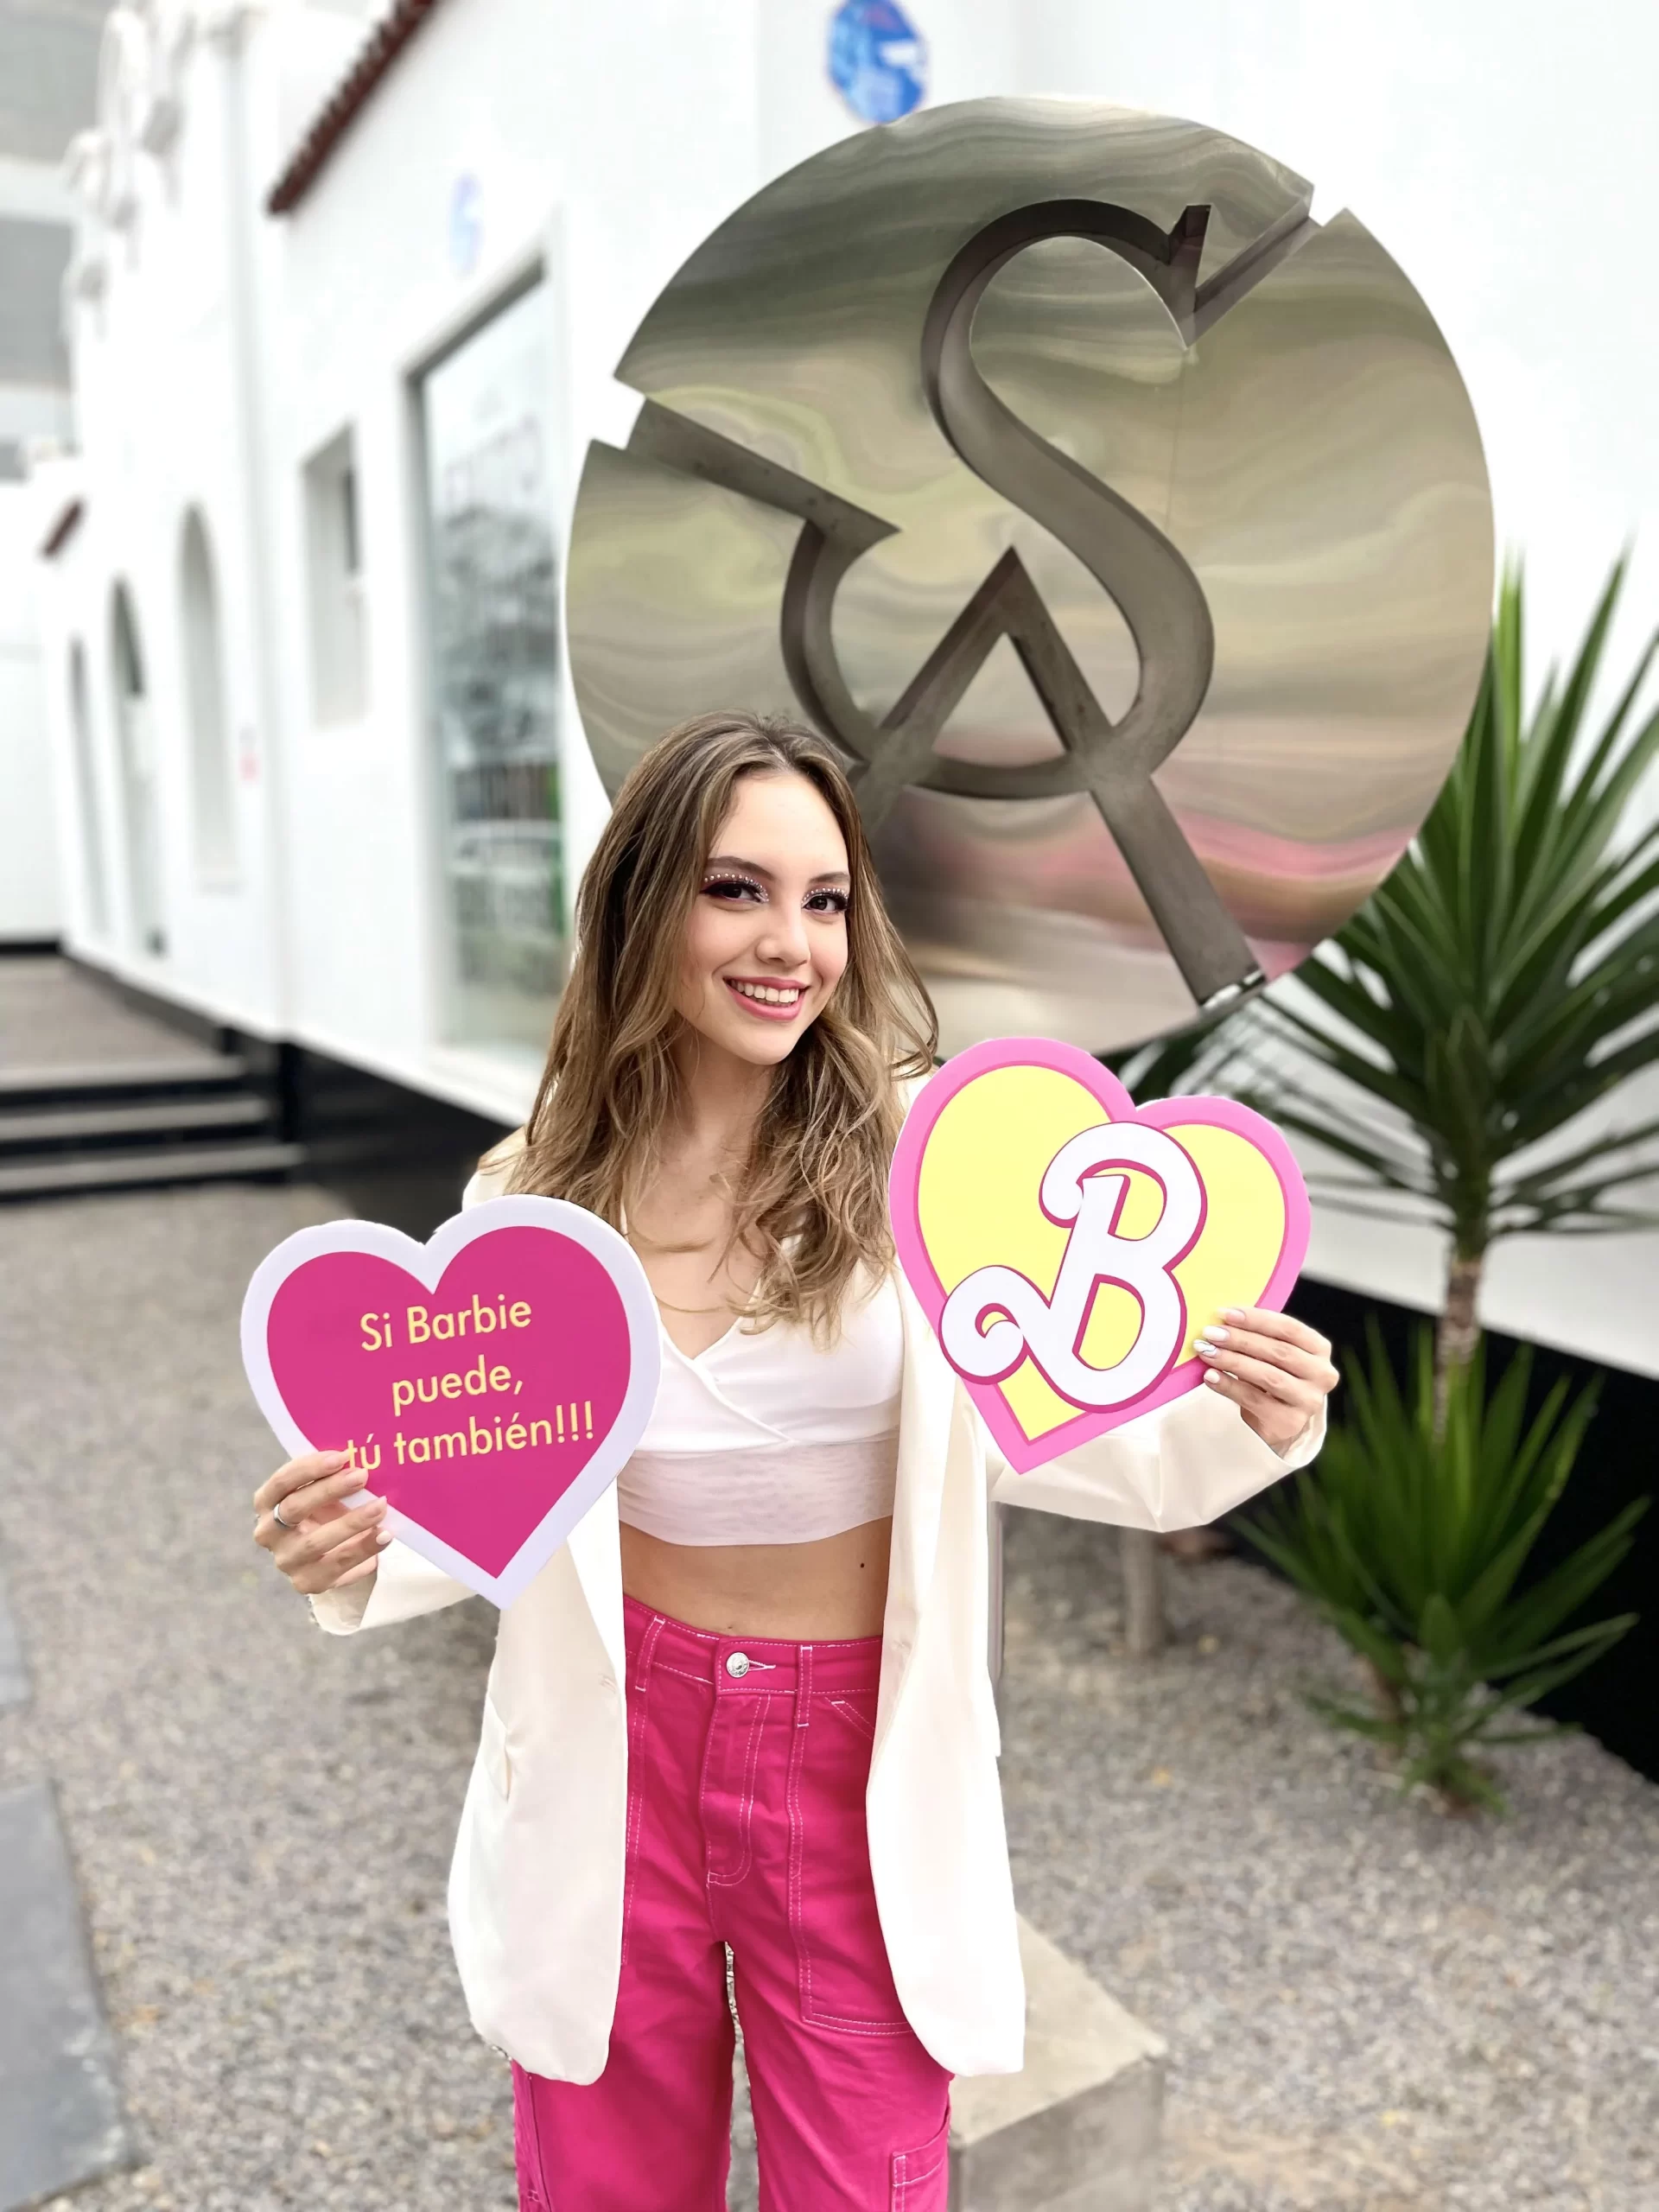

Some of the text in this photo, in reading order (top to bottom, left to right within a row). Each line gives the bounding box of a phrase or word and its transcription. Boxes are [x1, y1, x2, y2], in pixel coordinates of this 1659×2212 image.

[938, 1121, 1208, 1414] B
[359, 1293, 532, 1352] Si Barbie
[392, 1354, 524, 1417] puede,
[346, 1400, 594, 1471] tú también!!!
